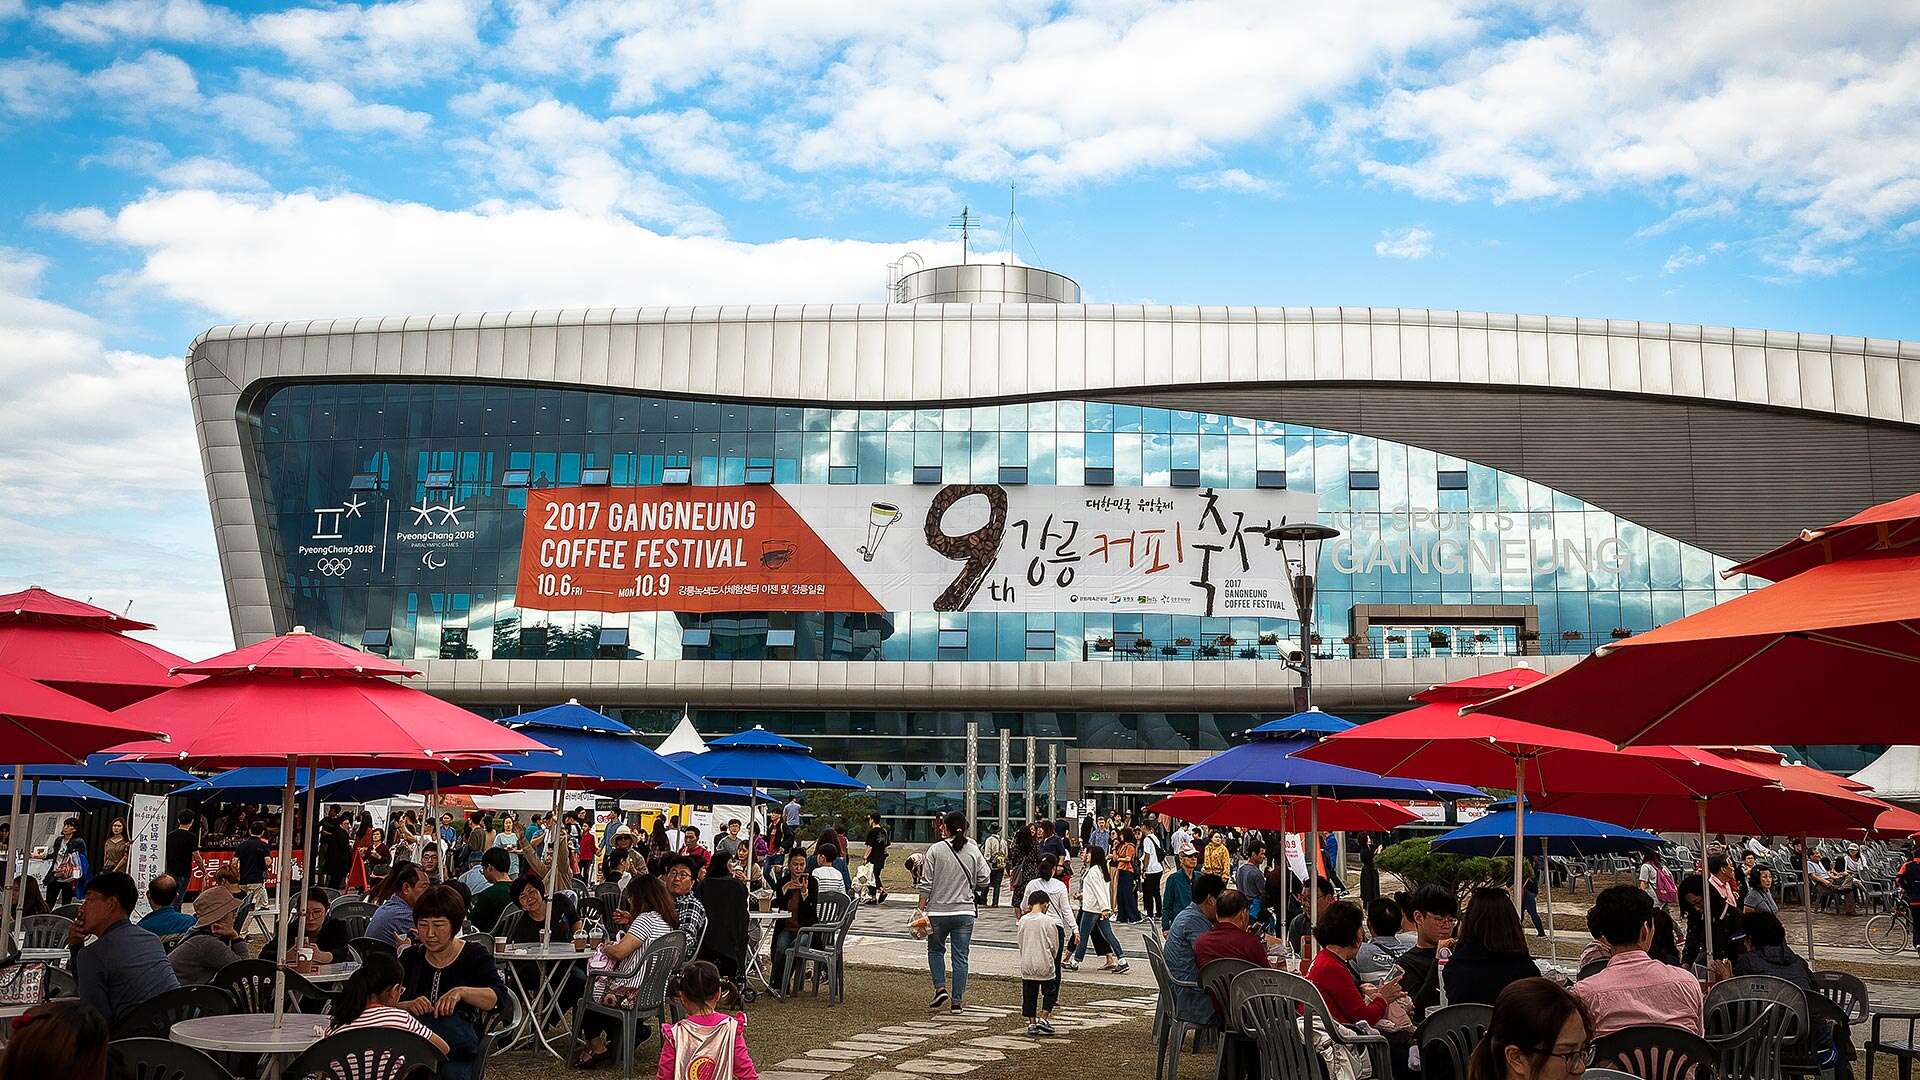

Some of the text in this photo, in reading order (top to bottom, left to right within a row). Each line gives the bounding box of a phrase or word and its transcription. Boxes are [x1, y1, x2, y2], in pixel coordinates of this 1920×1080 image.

[1086, 495, 1174, 514] 대한민국 유망축제
[544, 501, 756, 532] 2017 GANGNEUNG
[1330, 505, 1553, 533] ICE SPORTS in
[397, 532, 454, 543] PyeongChang
[299, 545, 354, 555] PyeongChang
[539, 538, 748, 569] COFFEE FESTIVAL
[1011, 513, 1081, 587] 강릉
[1088, 521, 1184, 575] 커피
[1331, 537, 1632, 575] GANGNEUNG
[537, 573, 671, 598] 10.6 FRI MON 10.9
[780, 585, 789, 595] 및
[791, 584, 825, 596] 강릉일원
[1225, 580, 1241, 588] 2017
[1225, 590, 1267, 598] GANGNEUNG
[1225, 600, 1285, 610] COFFEE FESTIVAL
